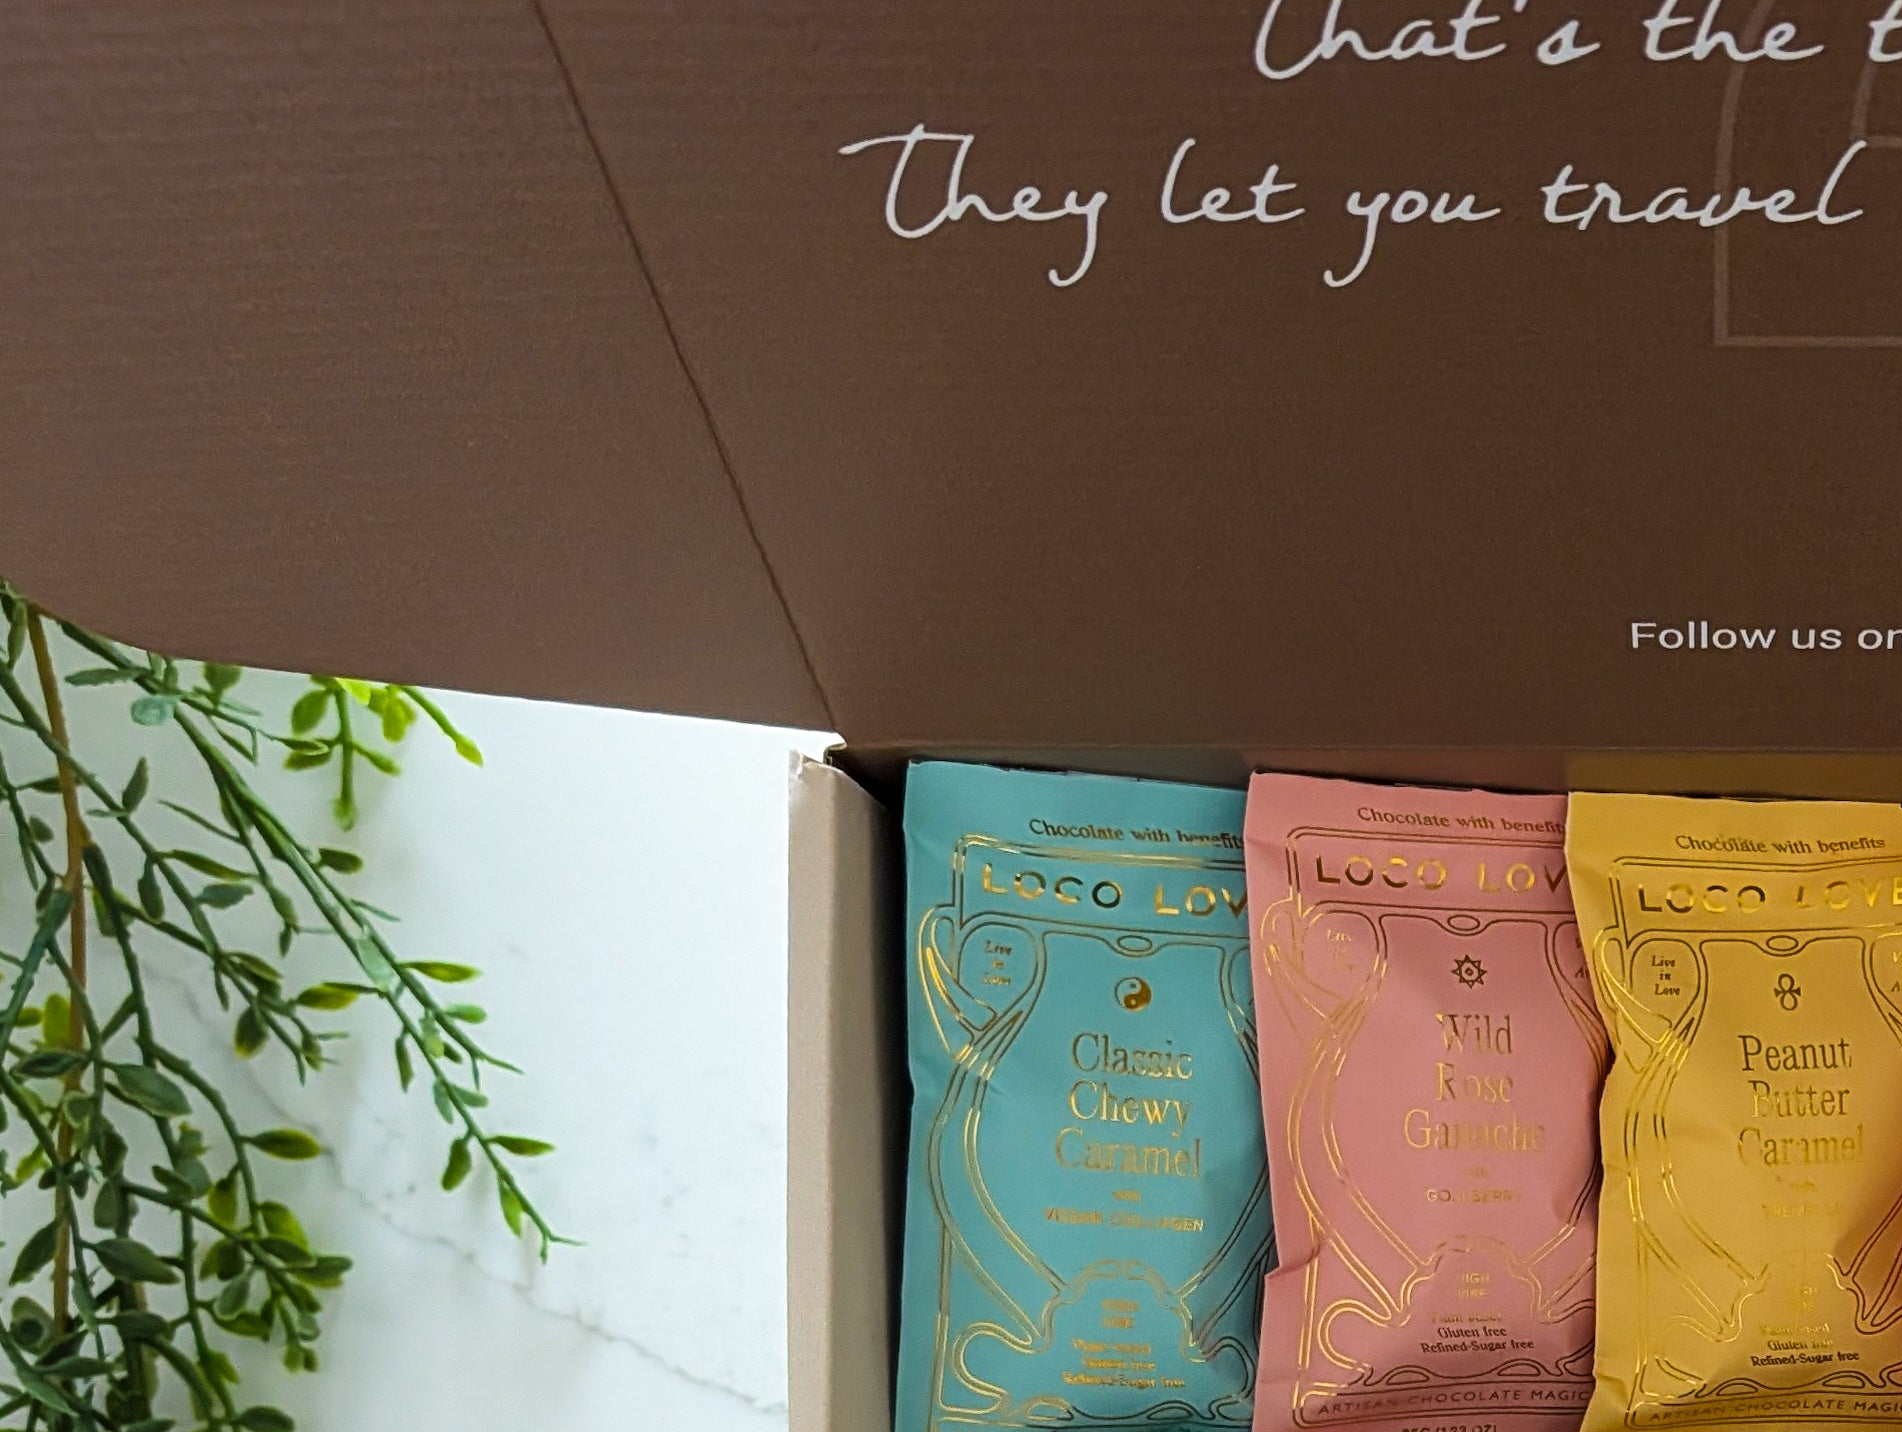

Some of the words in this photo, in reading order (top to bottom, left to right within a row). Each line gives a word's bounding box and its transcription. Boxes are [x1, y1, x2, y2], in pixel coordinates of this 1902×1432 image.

[1644, 0, 1823, 62] the
[839, 124, 1107, 287] They
[1160, 138, 1304, 226] let
[1322, 184, 1501, 287] you
[1542, 140, 1867, 231] travel
[1630, 620, 1780, 650] Follow
[1792, 626, 1842, 651] us
[1029, 819, 1125, 841] Chocolate
[1130, 827, 1171, 843] with
[1357, 806, 1450, 827] Chocolate
[1456, 815, 1497, 831] with
[1675, 835, 1766, 853] Chocolate
[1771, 840, 1812, 854] with
[1817, 837, 1886, 854] benefits
[981, 862, 1124, 910] LOCO
[1154, 883, 1248, 918] LOV
[1316, 855, 1448, 891] LOCO
[1478, 861, 1567, 893] LOV
[1637, 883, 1767, 914] LOCO
[1650, 955, 1676, 967] Live
[1654, 983, 1680, 996] Love
[1435, 1013, 1513, 1054] Wild
[1071, 1031, 1194, 1080] Classic
[1737, 1034, 1853, 1072] Peanut
[1434, 1061, 1514, 1103] Rose
[1748, 1080, 1850, 1118] Butter
[1068, 1078, 1192, 1140] Chewy
[1055, 1125, 1201, 1179] Caramel
[1737, 1123, 1864, 1167] Caramel
[1419, 1340, 1507, 1354] Refined-Sugar
[1510, 1339, 1536, 1350] free
[1750, 1353, 1834, 1367] Refined-Sugar
[1318, 1399, 1398, 1415] ARTISAN
[1405, 1389, 1522, 1406] CHOCOLATE
[1530, 1389, 1590, 1401] MAGIC
[1733, 1400, 1846, 1413] CHOCOLATE
